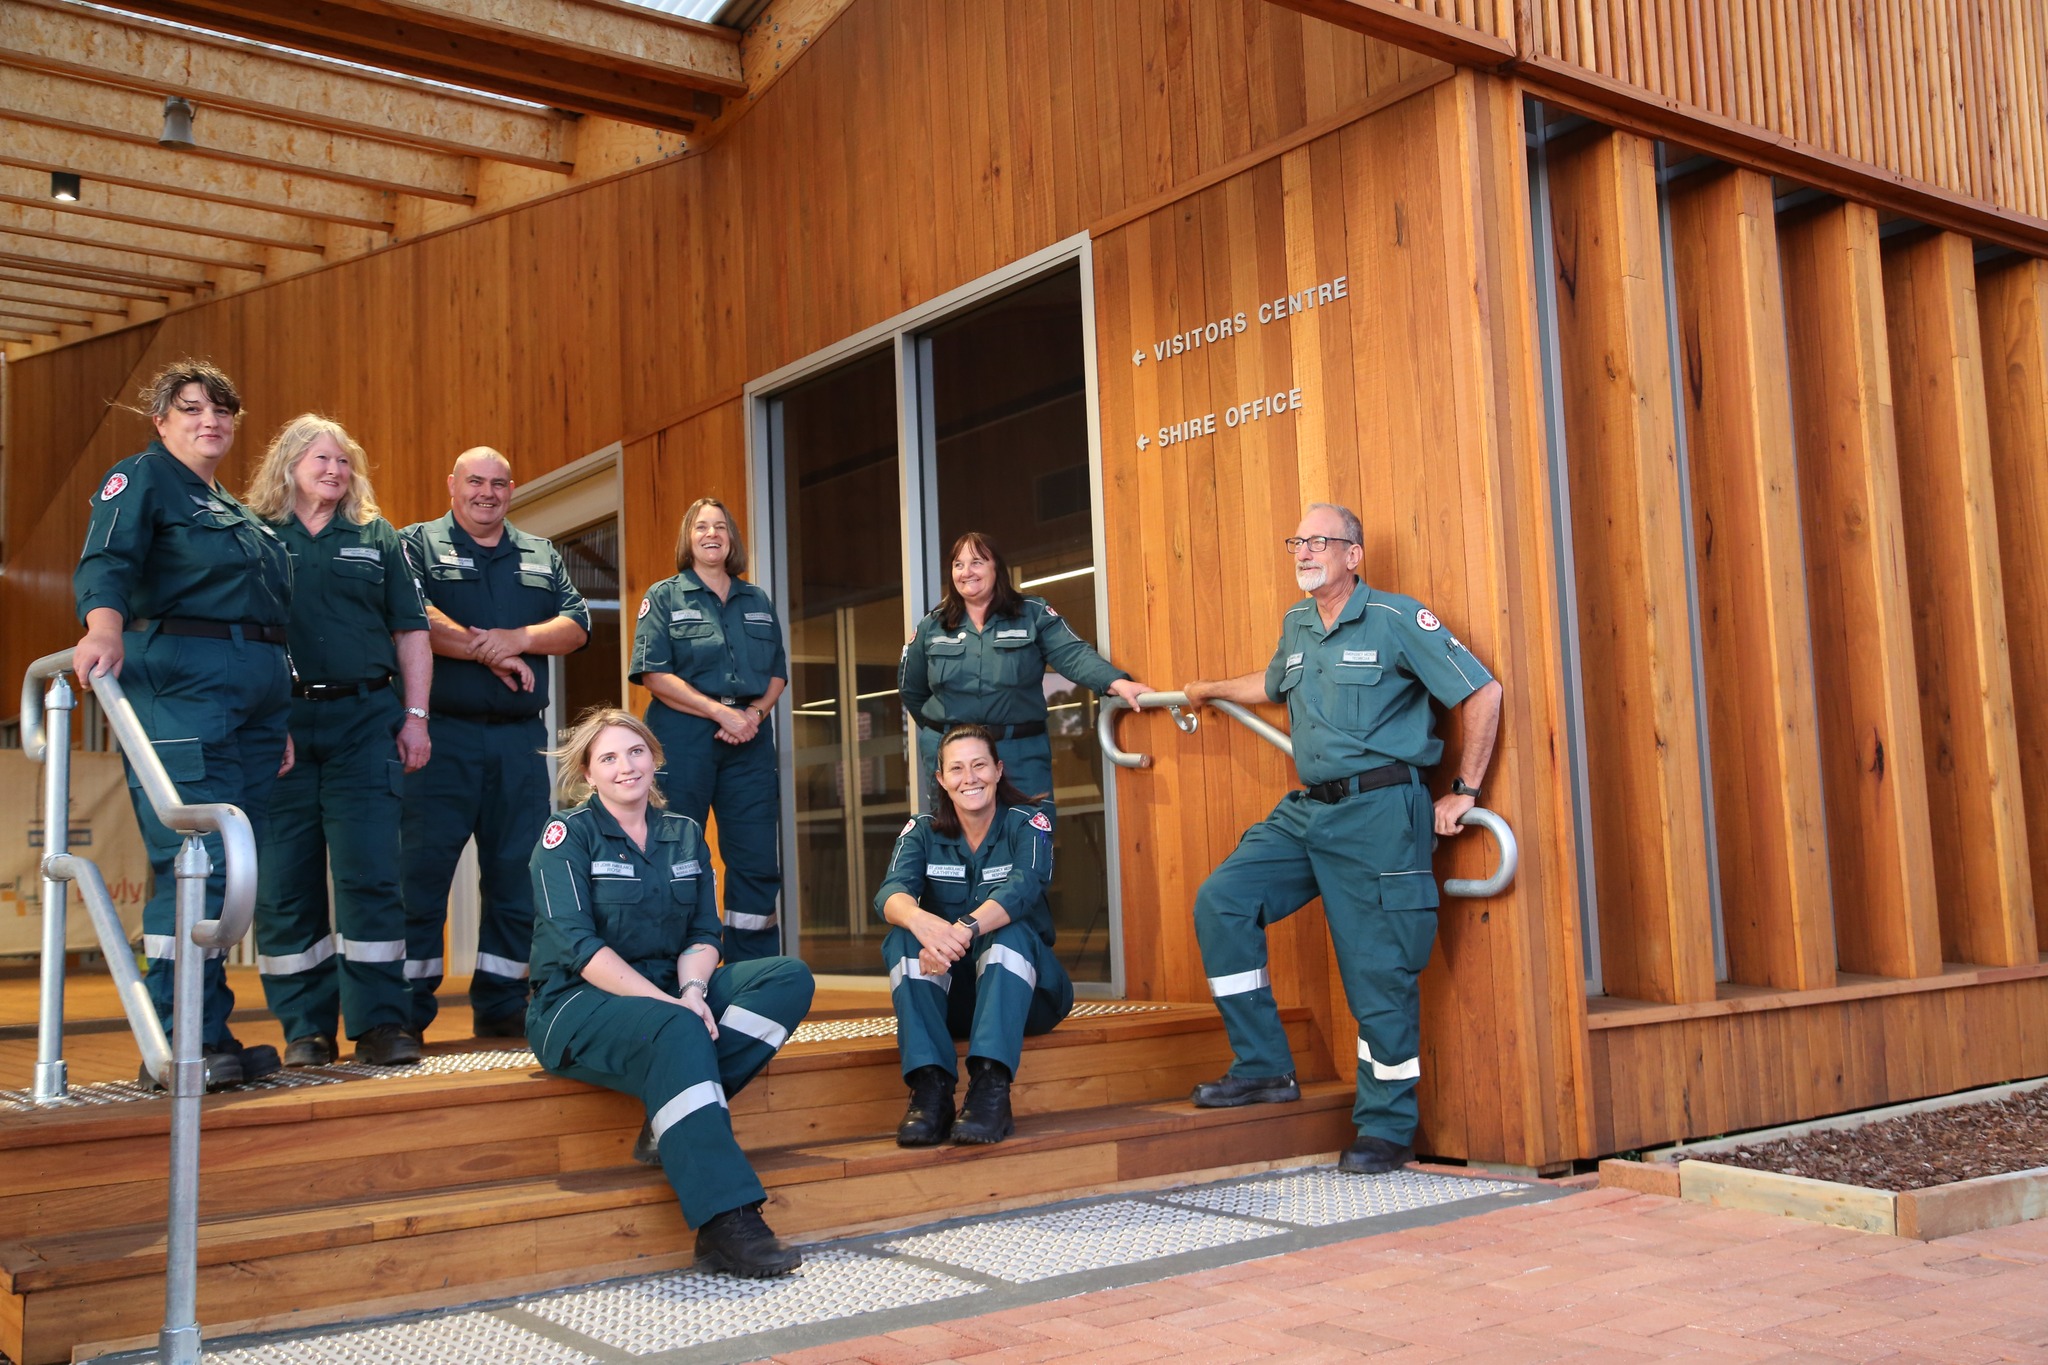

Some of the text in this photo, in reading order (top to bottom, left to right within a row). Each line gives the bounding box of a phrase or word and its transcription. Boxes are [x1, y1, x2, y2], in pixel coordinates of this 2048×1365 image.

[1153, 276, 1348, 361] VISITORS CENTRE
[1158, 387, 1302, 448] SHIRE OFFICE
